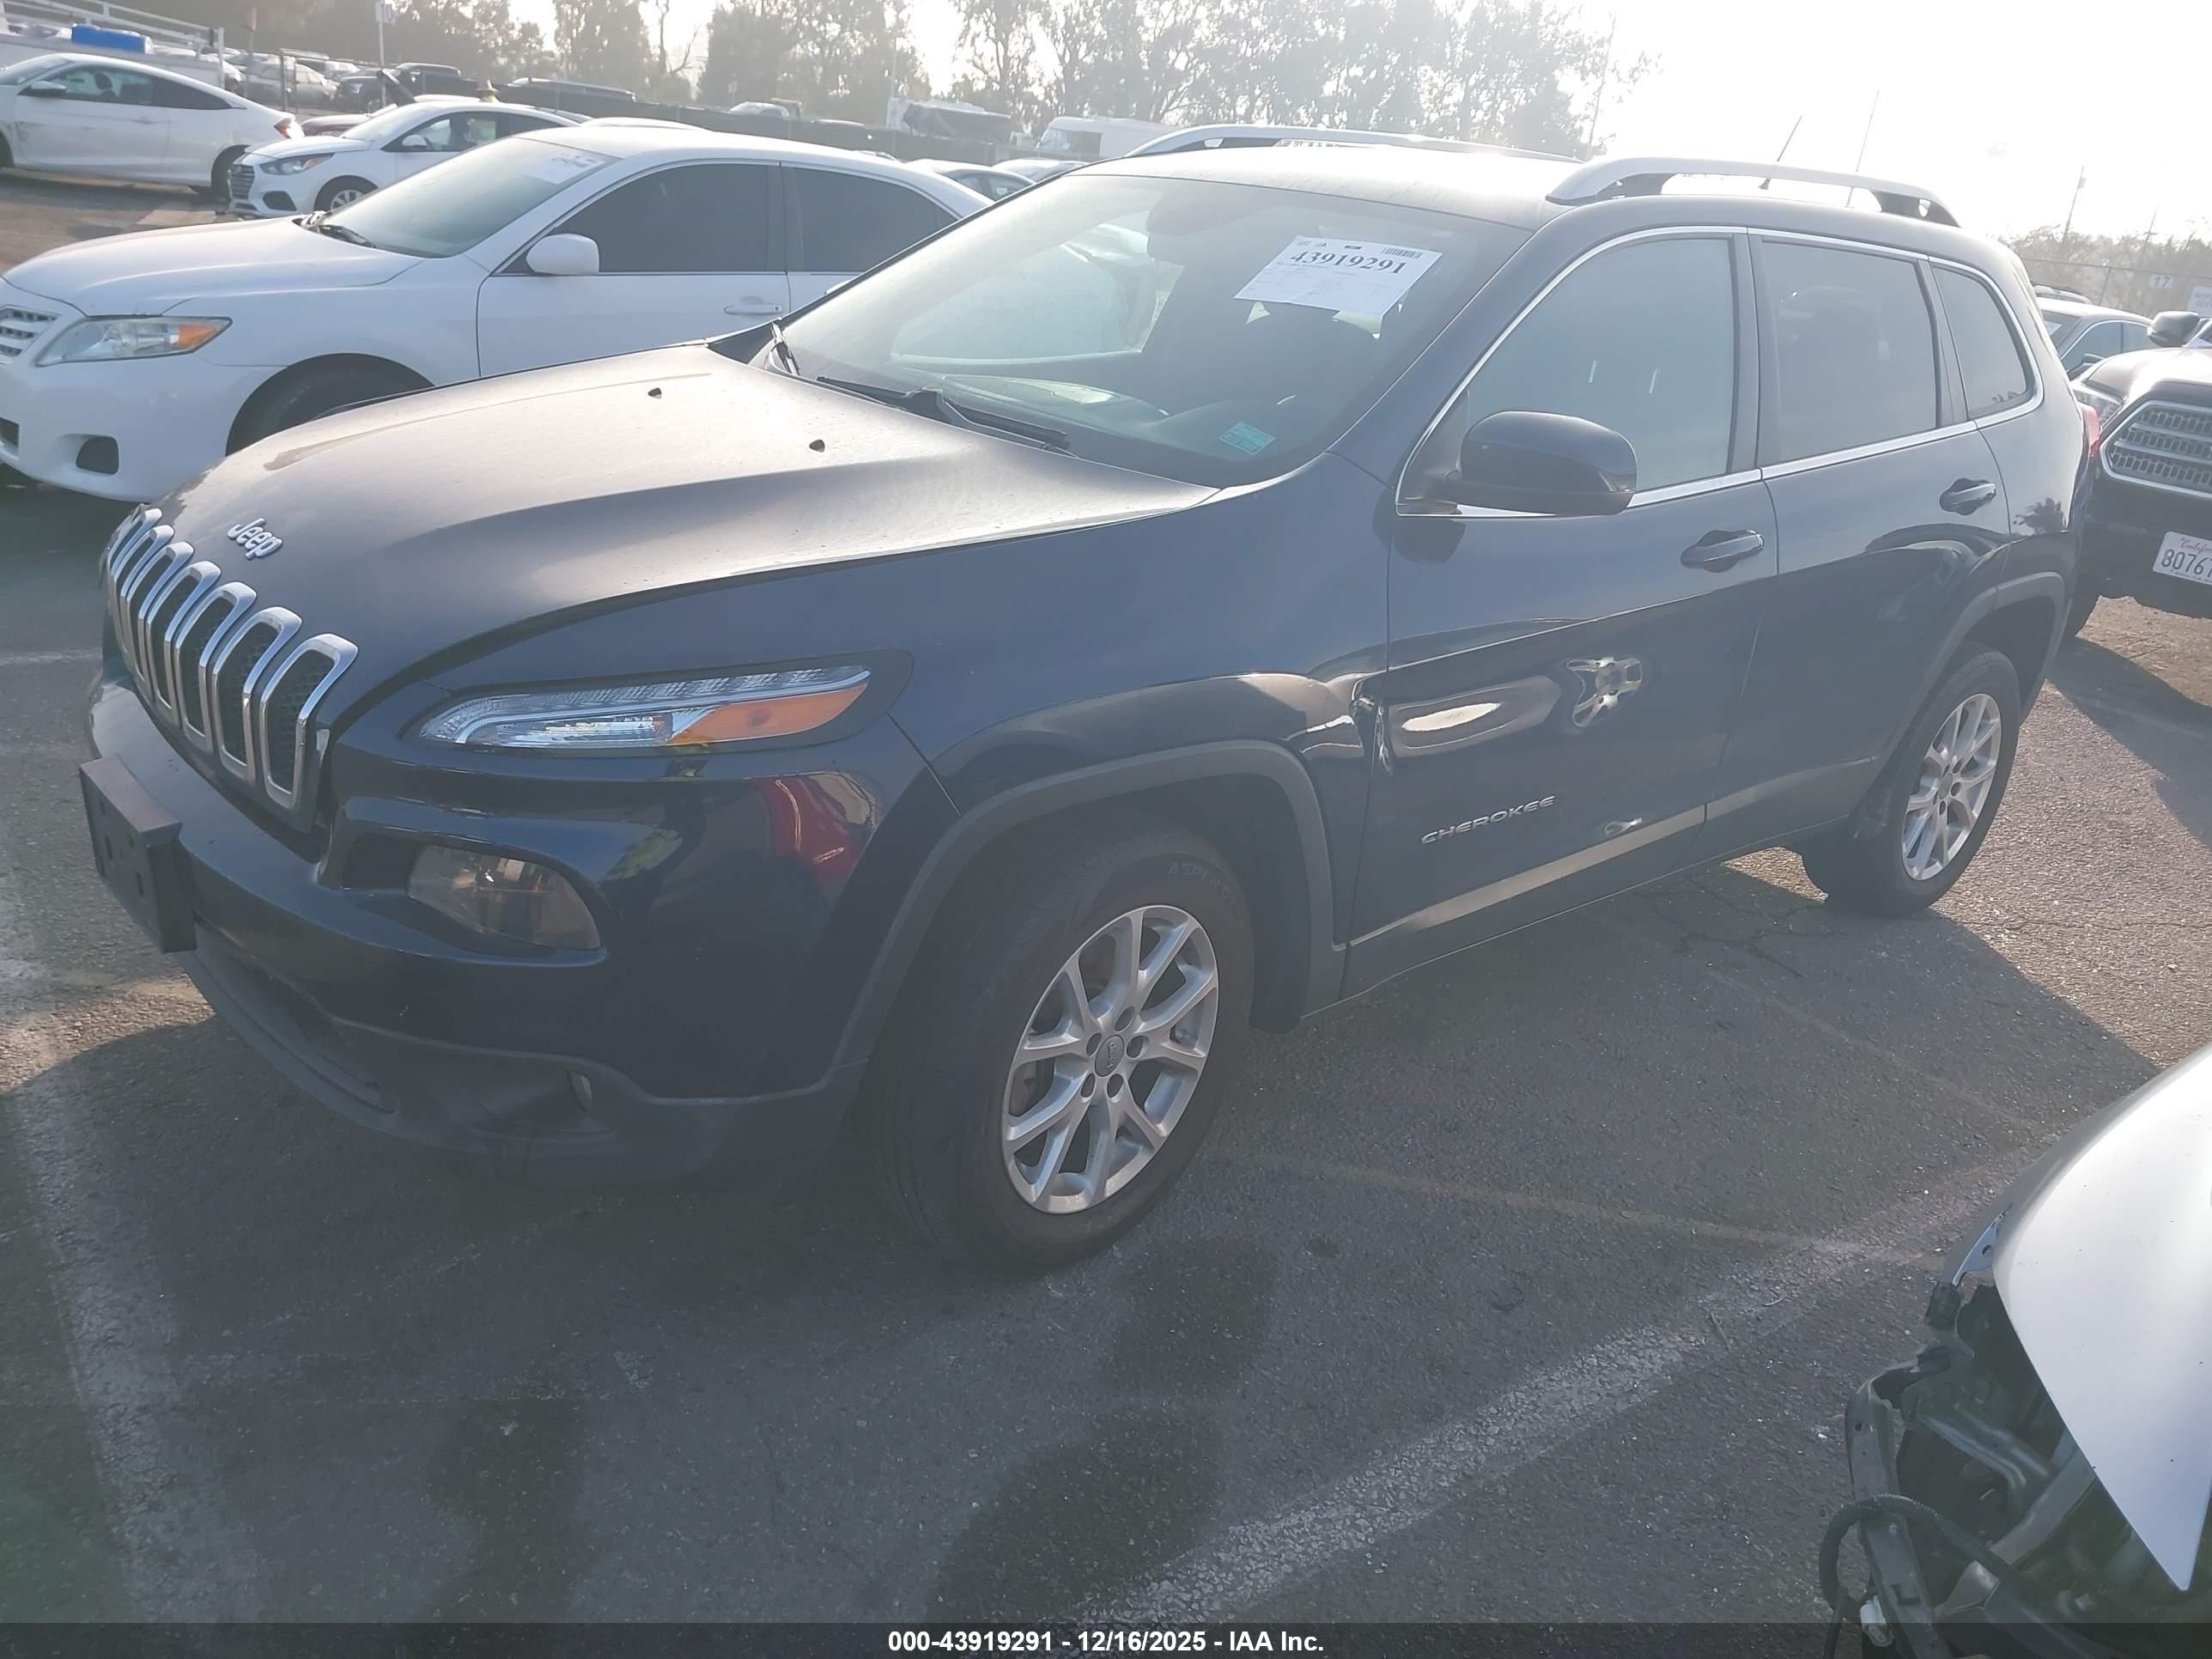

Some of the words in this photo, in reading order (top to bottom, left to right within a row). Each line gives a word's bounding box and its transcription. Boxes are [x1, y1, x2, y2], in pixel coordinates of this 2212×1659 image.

[1291, 250, 1407, 274] 43919291
[2155, 276, 2171, 288] 17
[227, 518, 283, 560] Jeep
[1421, 795, 1555, 844] CHEROKEE
